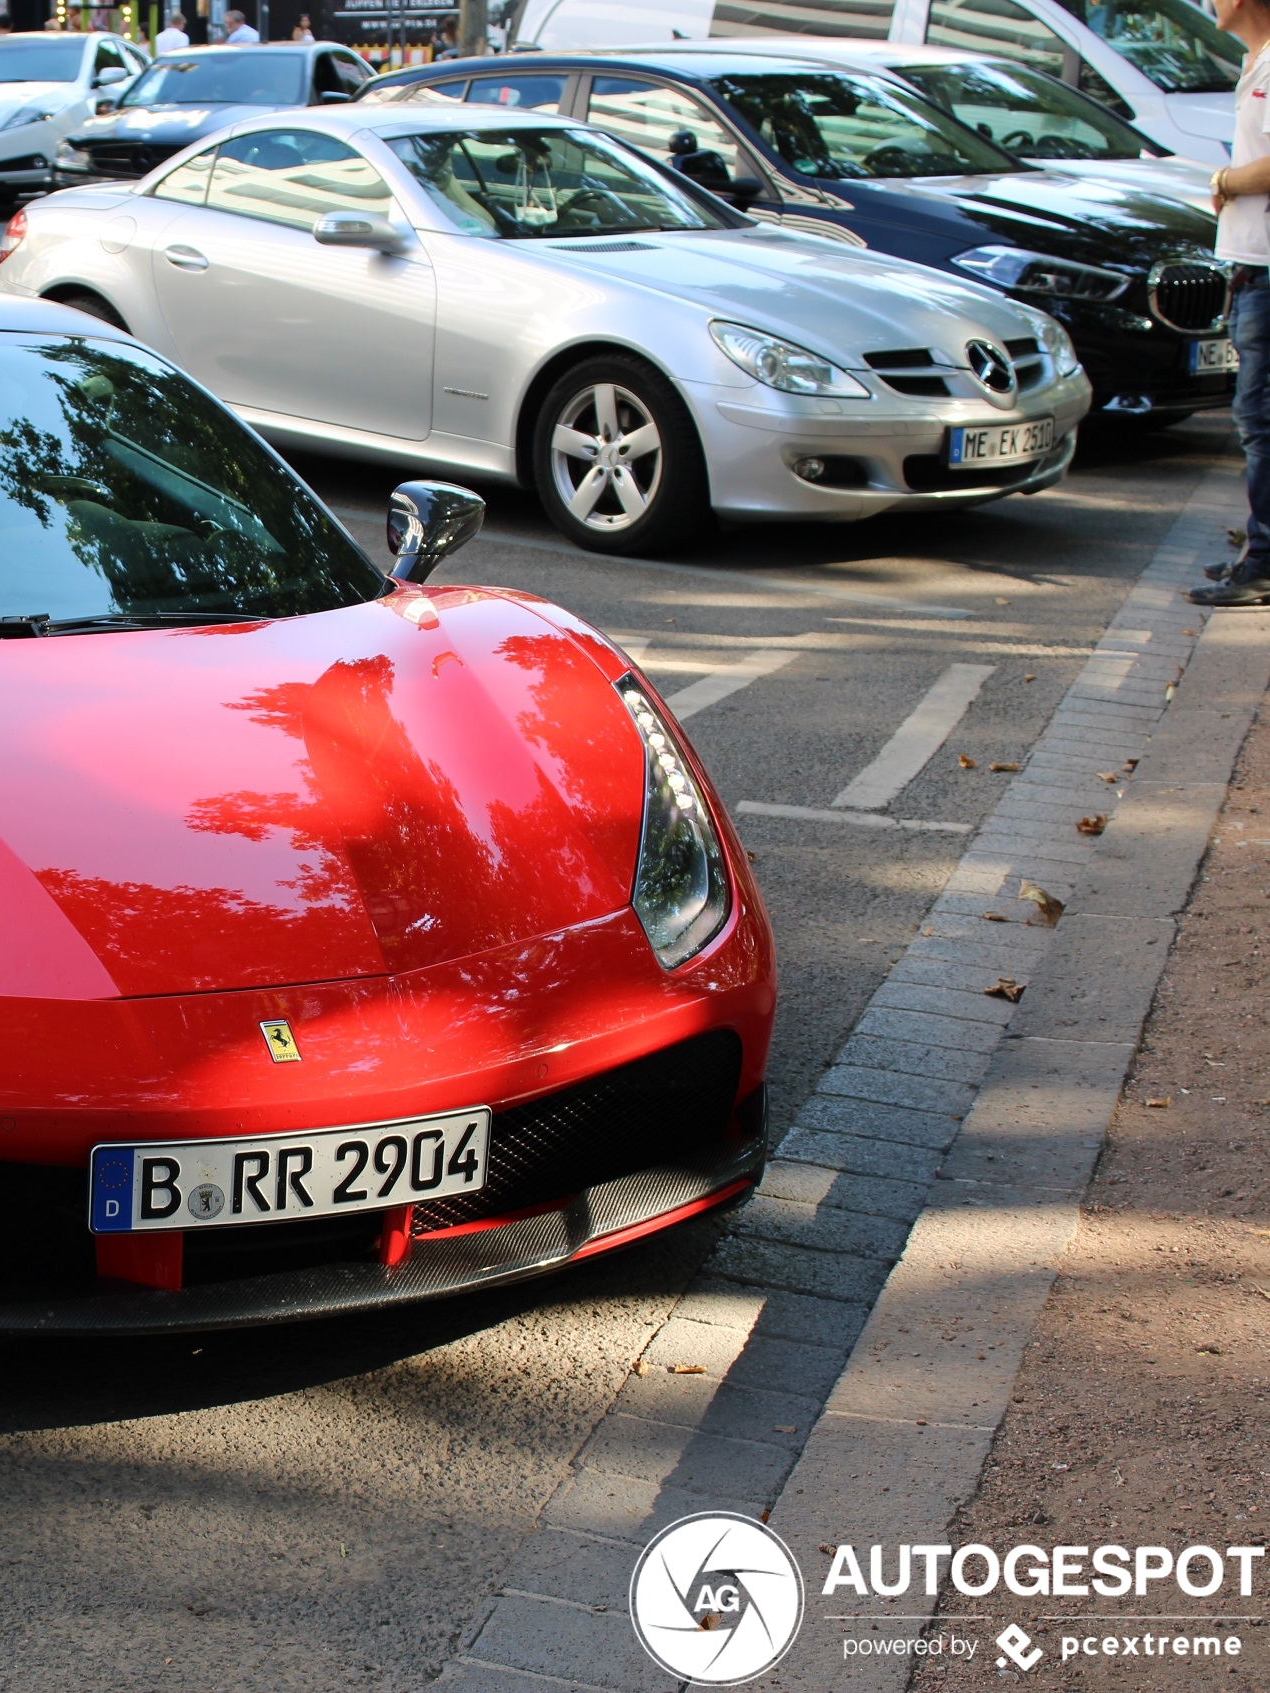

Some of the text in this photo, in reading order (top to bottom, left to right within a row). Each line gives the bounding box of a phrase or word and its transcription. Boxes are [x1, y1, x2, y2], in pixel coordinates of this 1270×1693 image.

[964, 432, 988, 457] ME
[1000, 429, 1019, 455] EK
[1022, 422, 1052, 453] 2510
[105, 1122, 480, 1220] D B RR 2904
